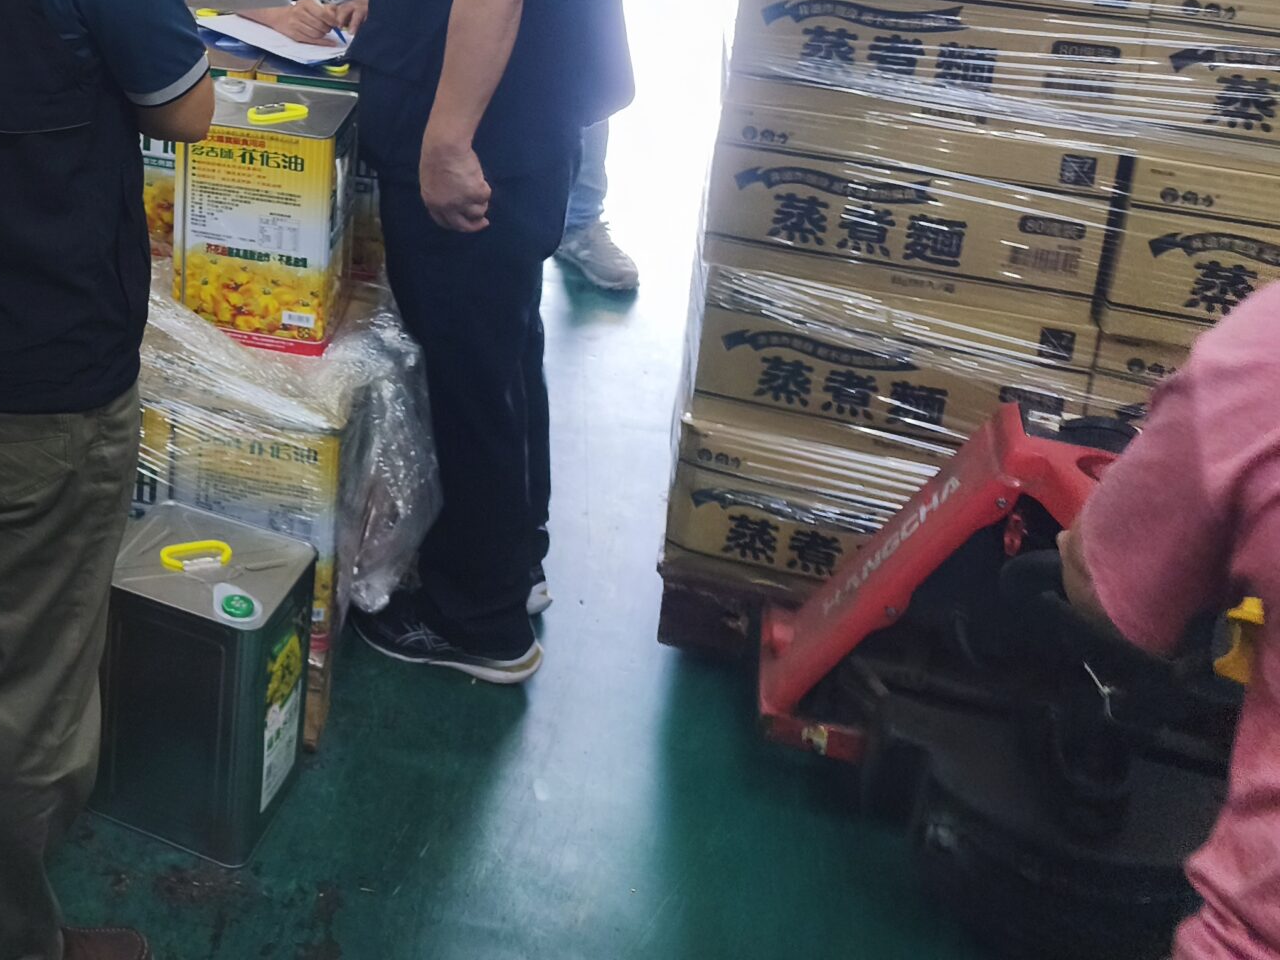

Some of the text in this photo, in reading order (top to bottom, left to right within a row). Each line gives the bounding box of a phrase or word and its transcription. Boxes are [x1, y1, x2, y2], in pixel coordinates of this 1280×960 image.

[236, 147, 305, 173] 芥花油
[766, 192, 968, 267] 蒸煮麵
[753, 355, 949, 427] 蒸煮麵
[723, 514, 843, 576] 蒸煮
